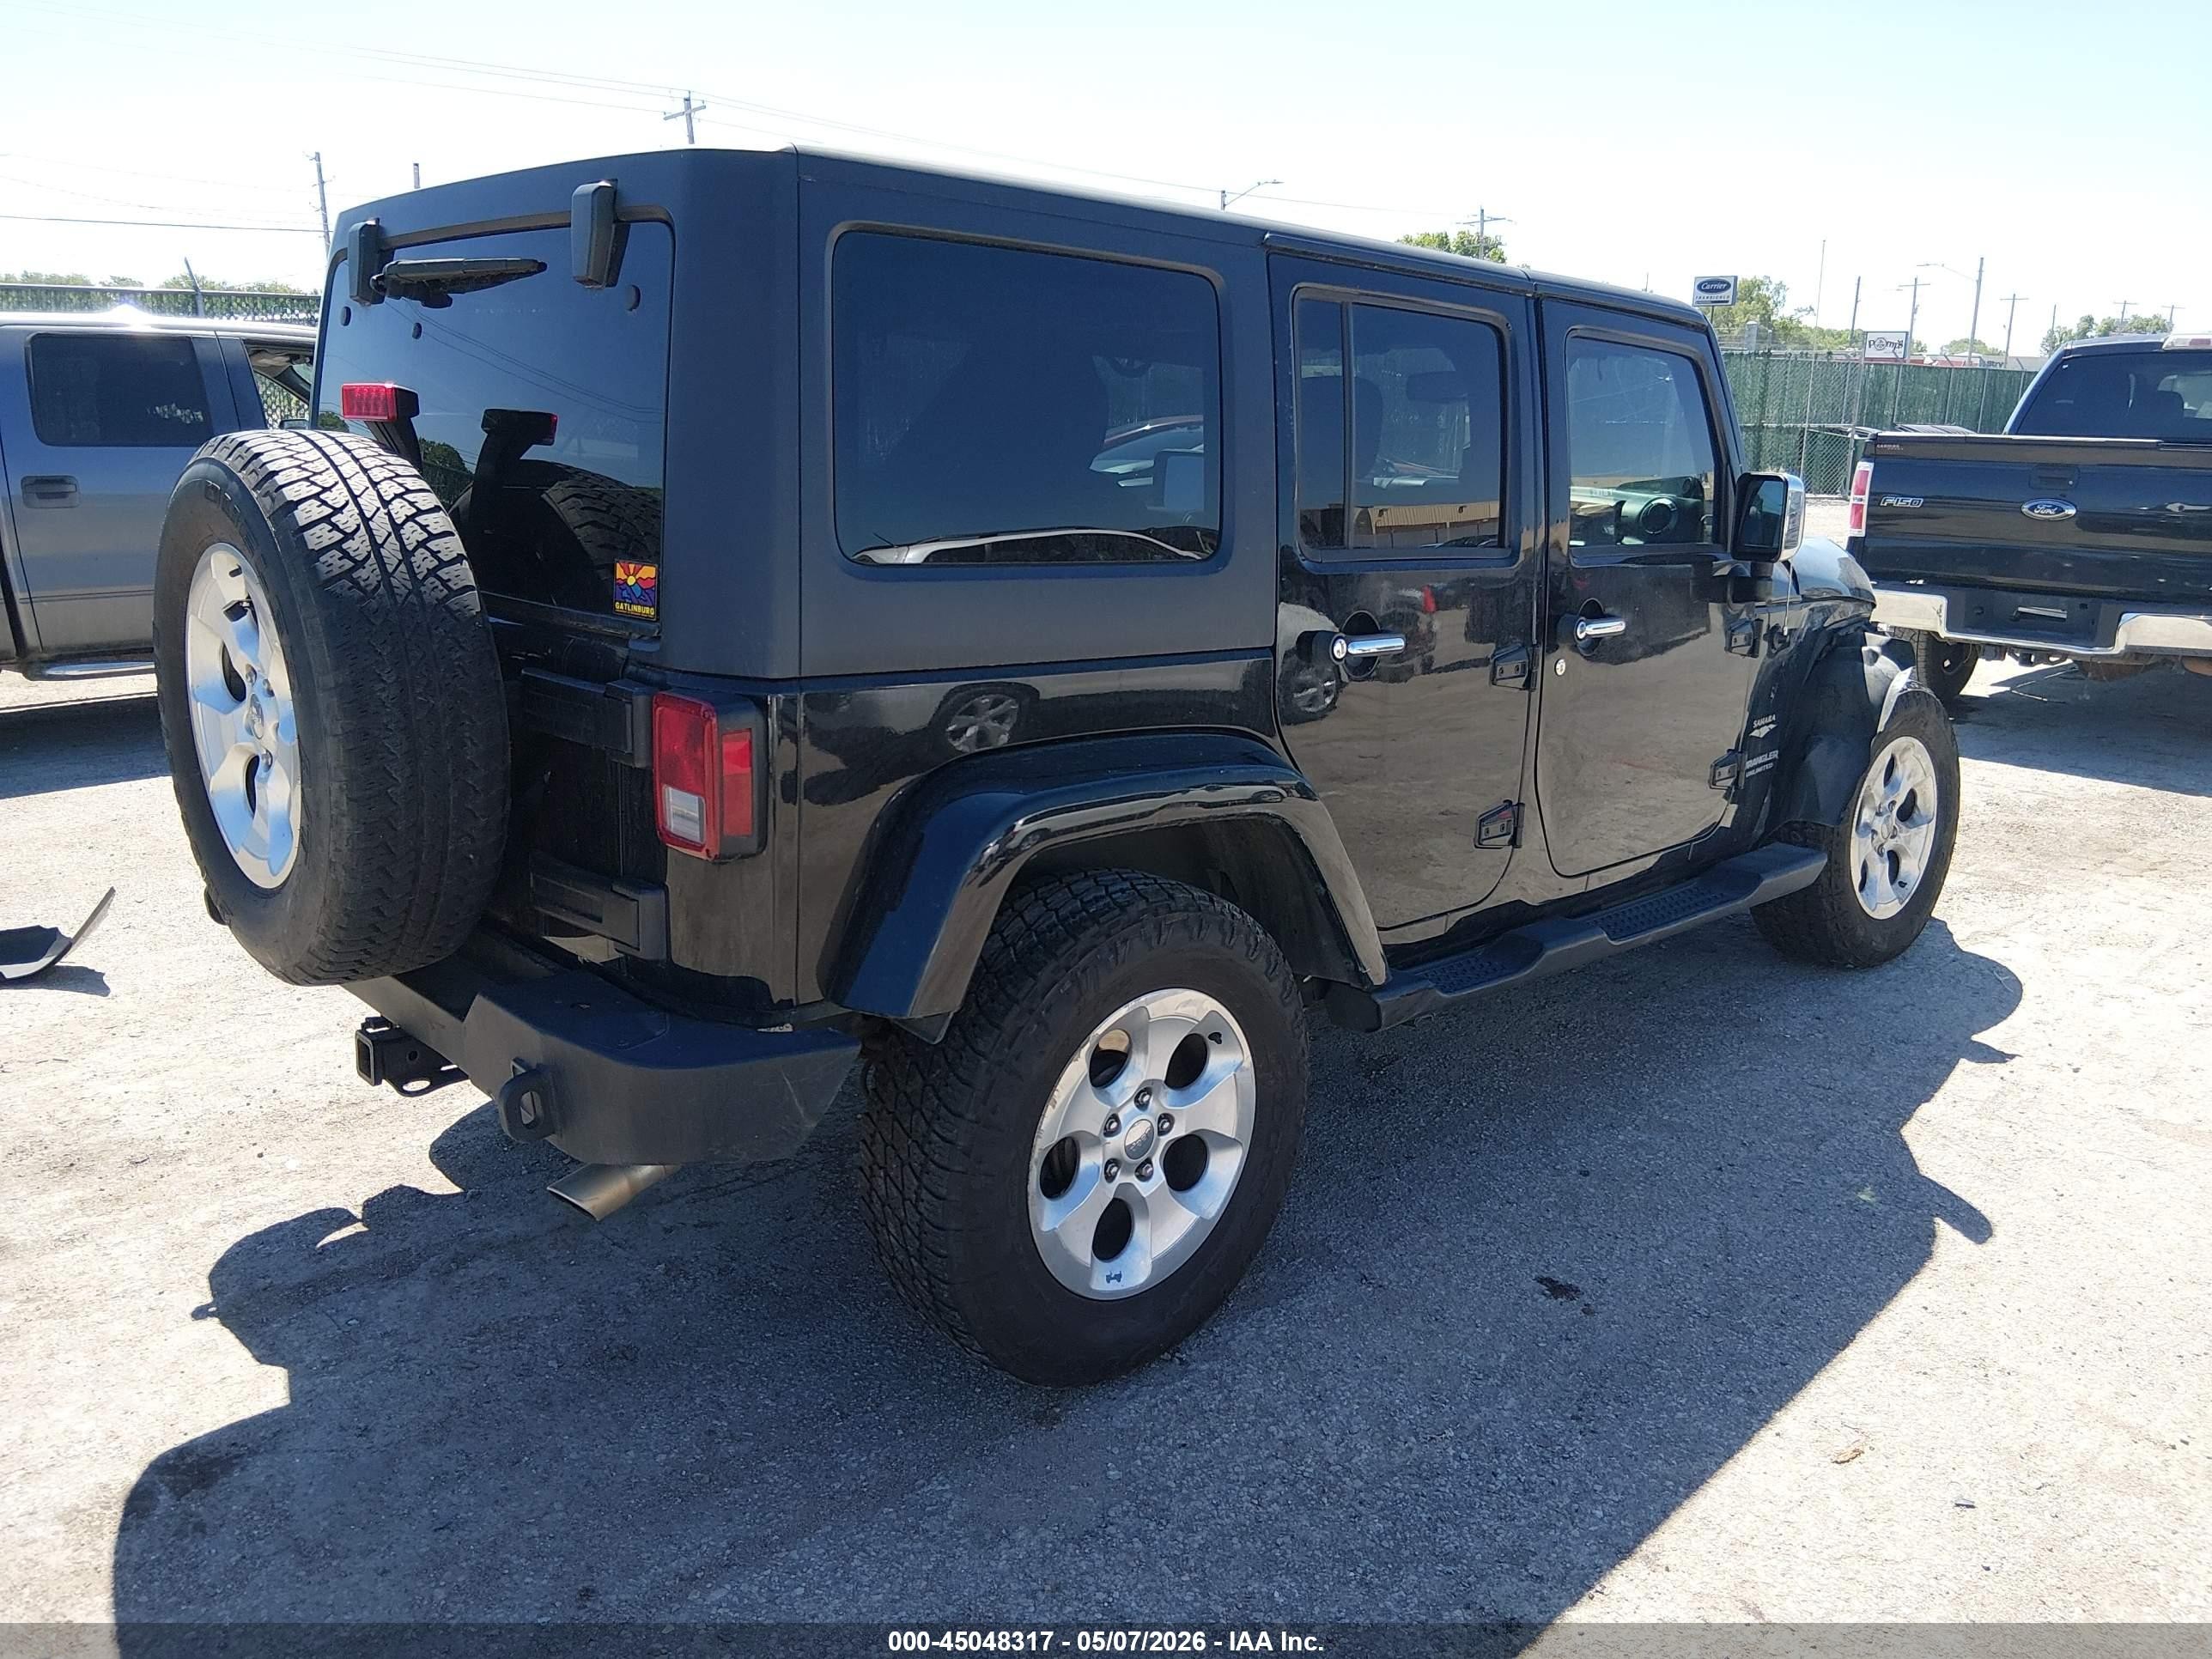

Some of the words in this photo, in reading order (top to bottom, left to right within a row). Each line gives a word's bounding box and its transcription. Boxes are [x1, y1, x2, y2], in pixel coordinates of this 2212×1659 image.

[1701, 282, 1728, 290] Carrier
[1880, 496, 1924, 508] F-150
[2033, 504, 2058, 515] Ford
[615, 602, 655, 616] GATLINBURG
[1753, 714, 1776, 729] SAHARA
[1745, 750, 1779, 770] RANGLER
